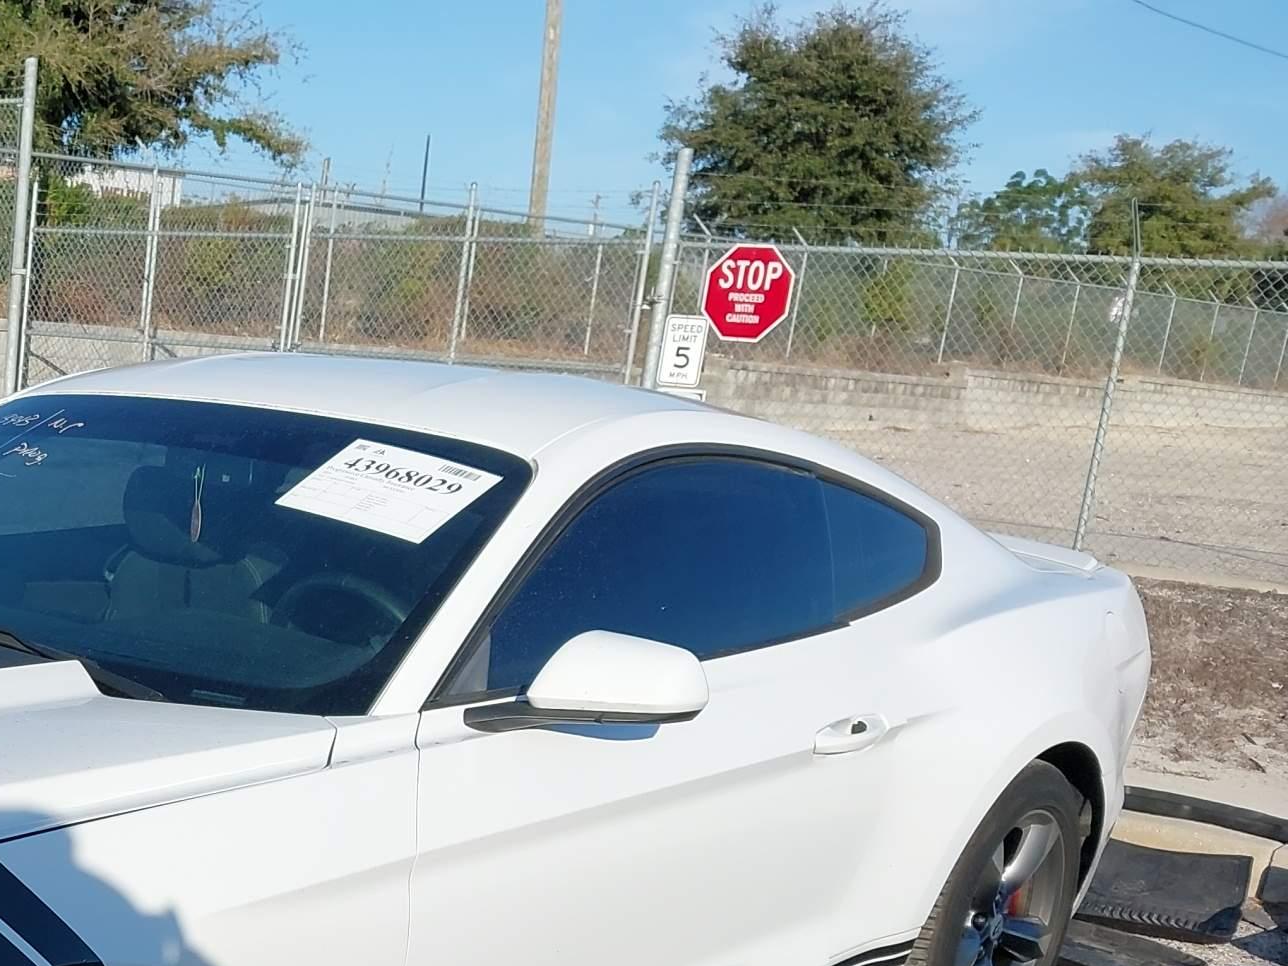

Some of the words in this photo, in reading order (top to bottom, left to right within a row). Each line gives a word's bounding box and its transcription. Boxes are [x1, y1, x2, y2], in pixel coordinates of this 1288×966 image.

[718, 260, 783, 290] STOP
[728, 292, 765, 303] PROCEED
[734, 303, 755, 313] WITH
[725, 313, 760, 324] CAUTION
[671, 324, 704, 333] SPEED
[672, 334, 698, 343] LIMIT
[673, 346, 691, 368] 5
[669, 371, 688, 379] MPH
[343, 457, 463, 494] 43968029
